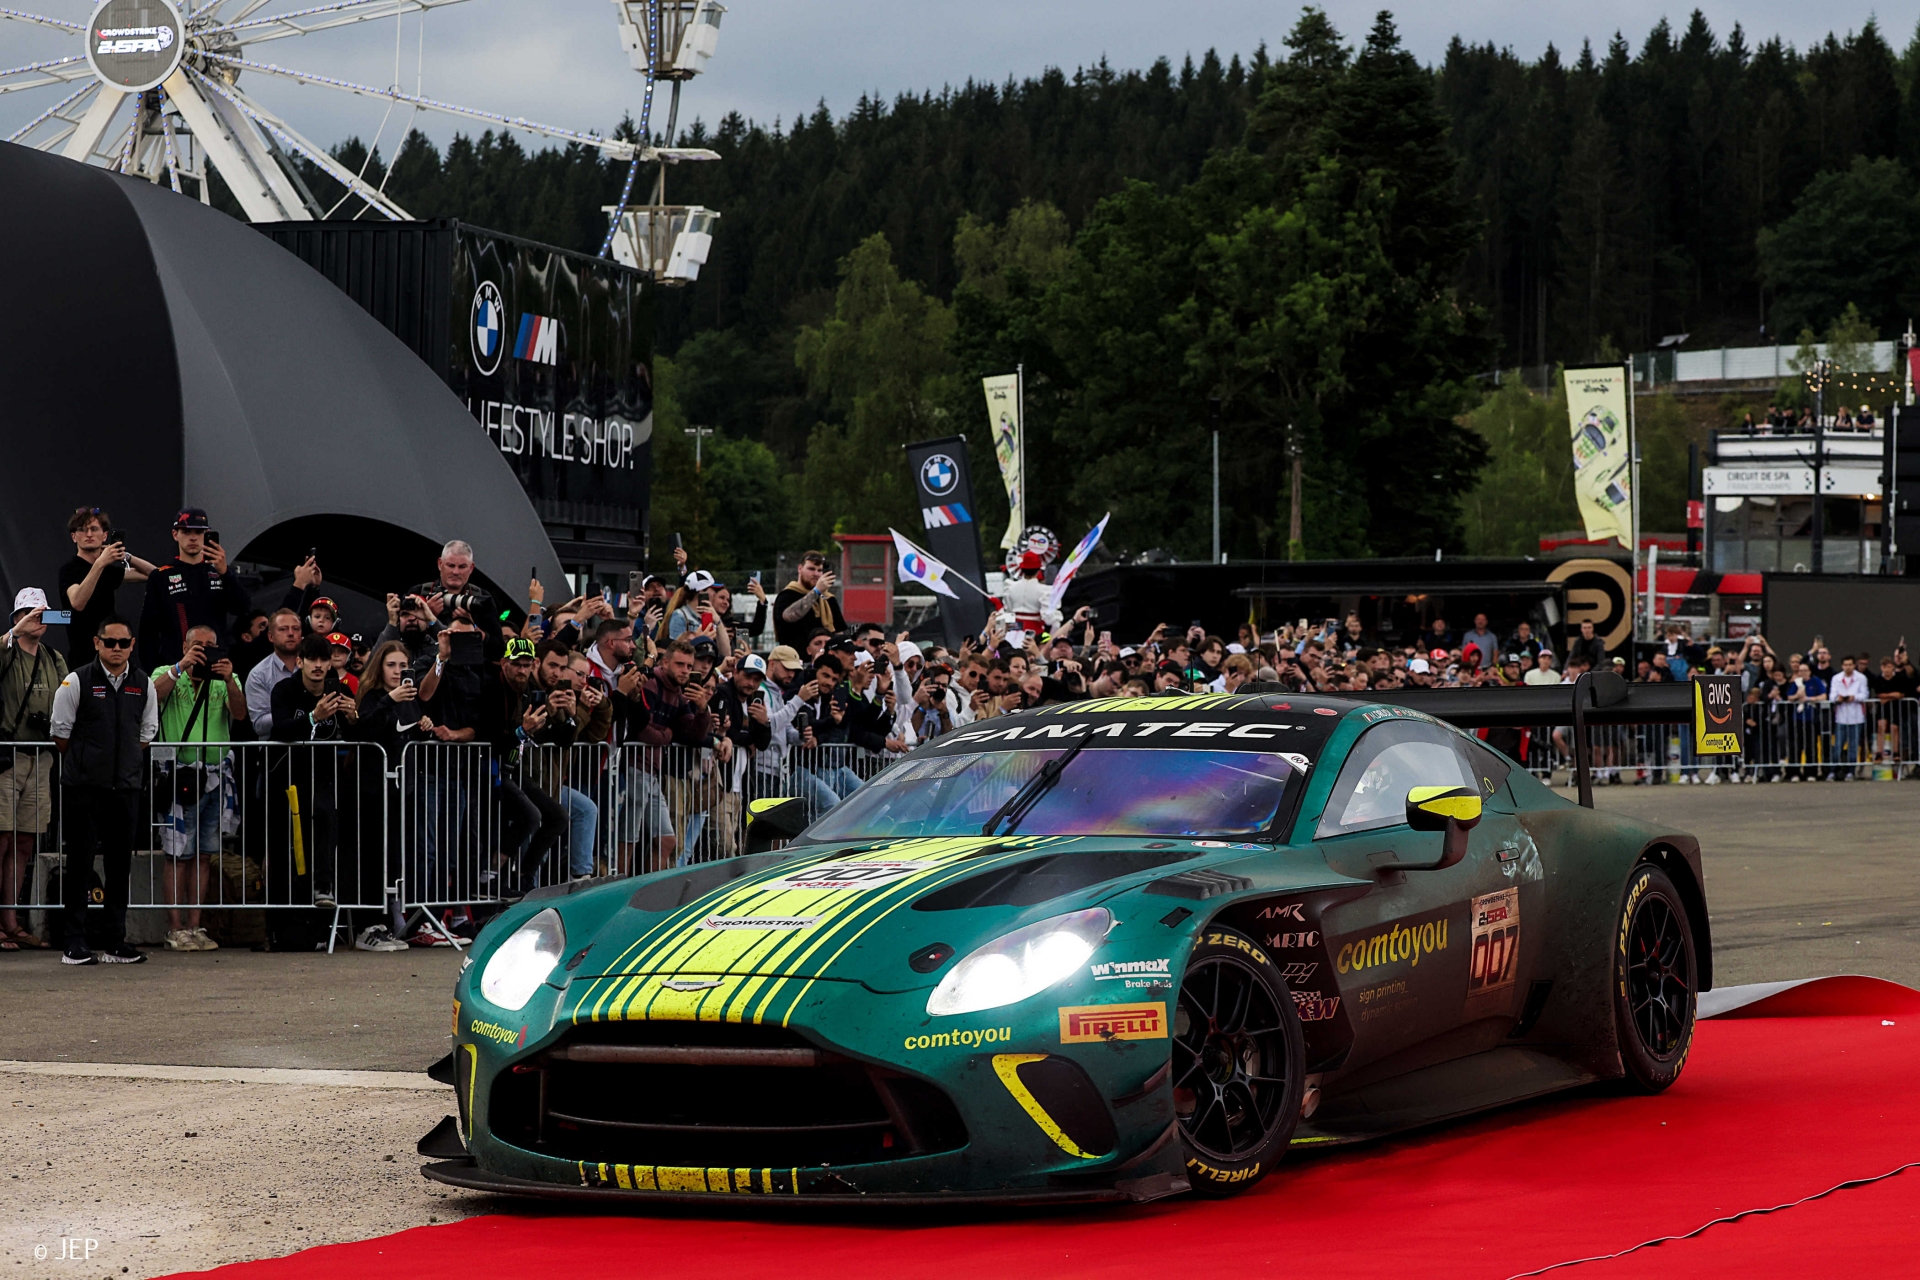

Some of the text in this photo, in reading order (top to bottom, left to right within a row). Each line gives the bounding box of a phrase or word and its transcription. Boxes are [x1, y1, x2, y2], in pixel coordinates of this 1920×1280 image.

[101, 27, 158, 37] CROWDSTRIKE
[476, 286, 501, 313] BMW
[468, 398, 633, 470] IFESTYLE SHOP.
[1727, 471, 1790, 481] CIRCUIT DE SPA
[1708, 683, 1731, 705] aws
[935, 722, 1293, 748] FANATEC
[785, 868, 918, 881] 007
[1256, 903, 1306, 921] AMR
[1337, 919, 1448, 974] comtoyou
[1470, 925, 1518, 989] 007
[1125, 979, 1151, 988] Brake
[1359, 988, 1375, 1004] sign
[471, 1019, 518, 1044] comtoyou
[1069, 1009, 1158, 1036] PIRELLI
[904, 1027, 1011, 1050] comtoyou
[1186, 1158, 1260, 1182] PIRELLI
